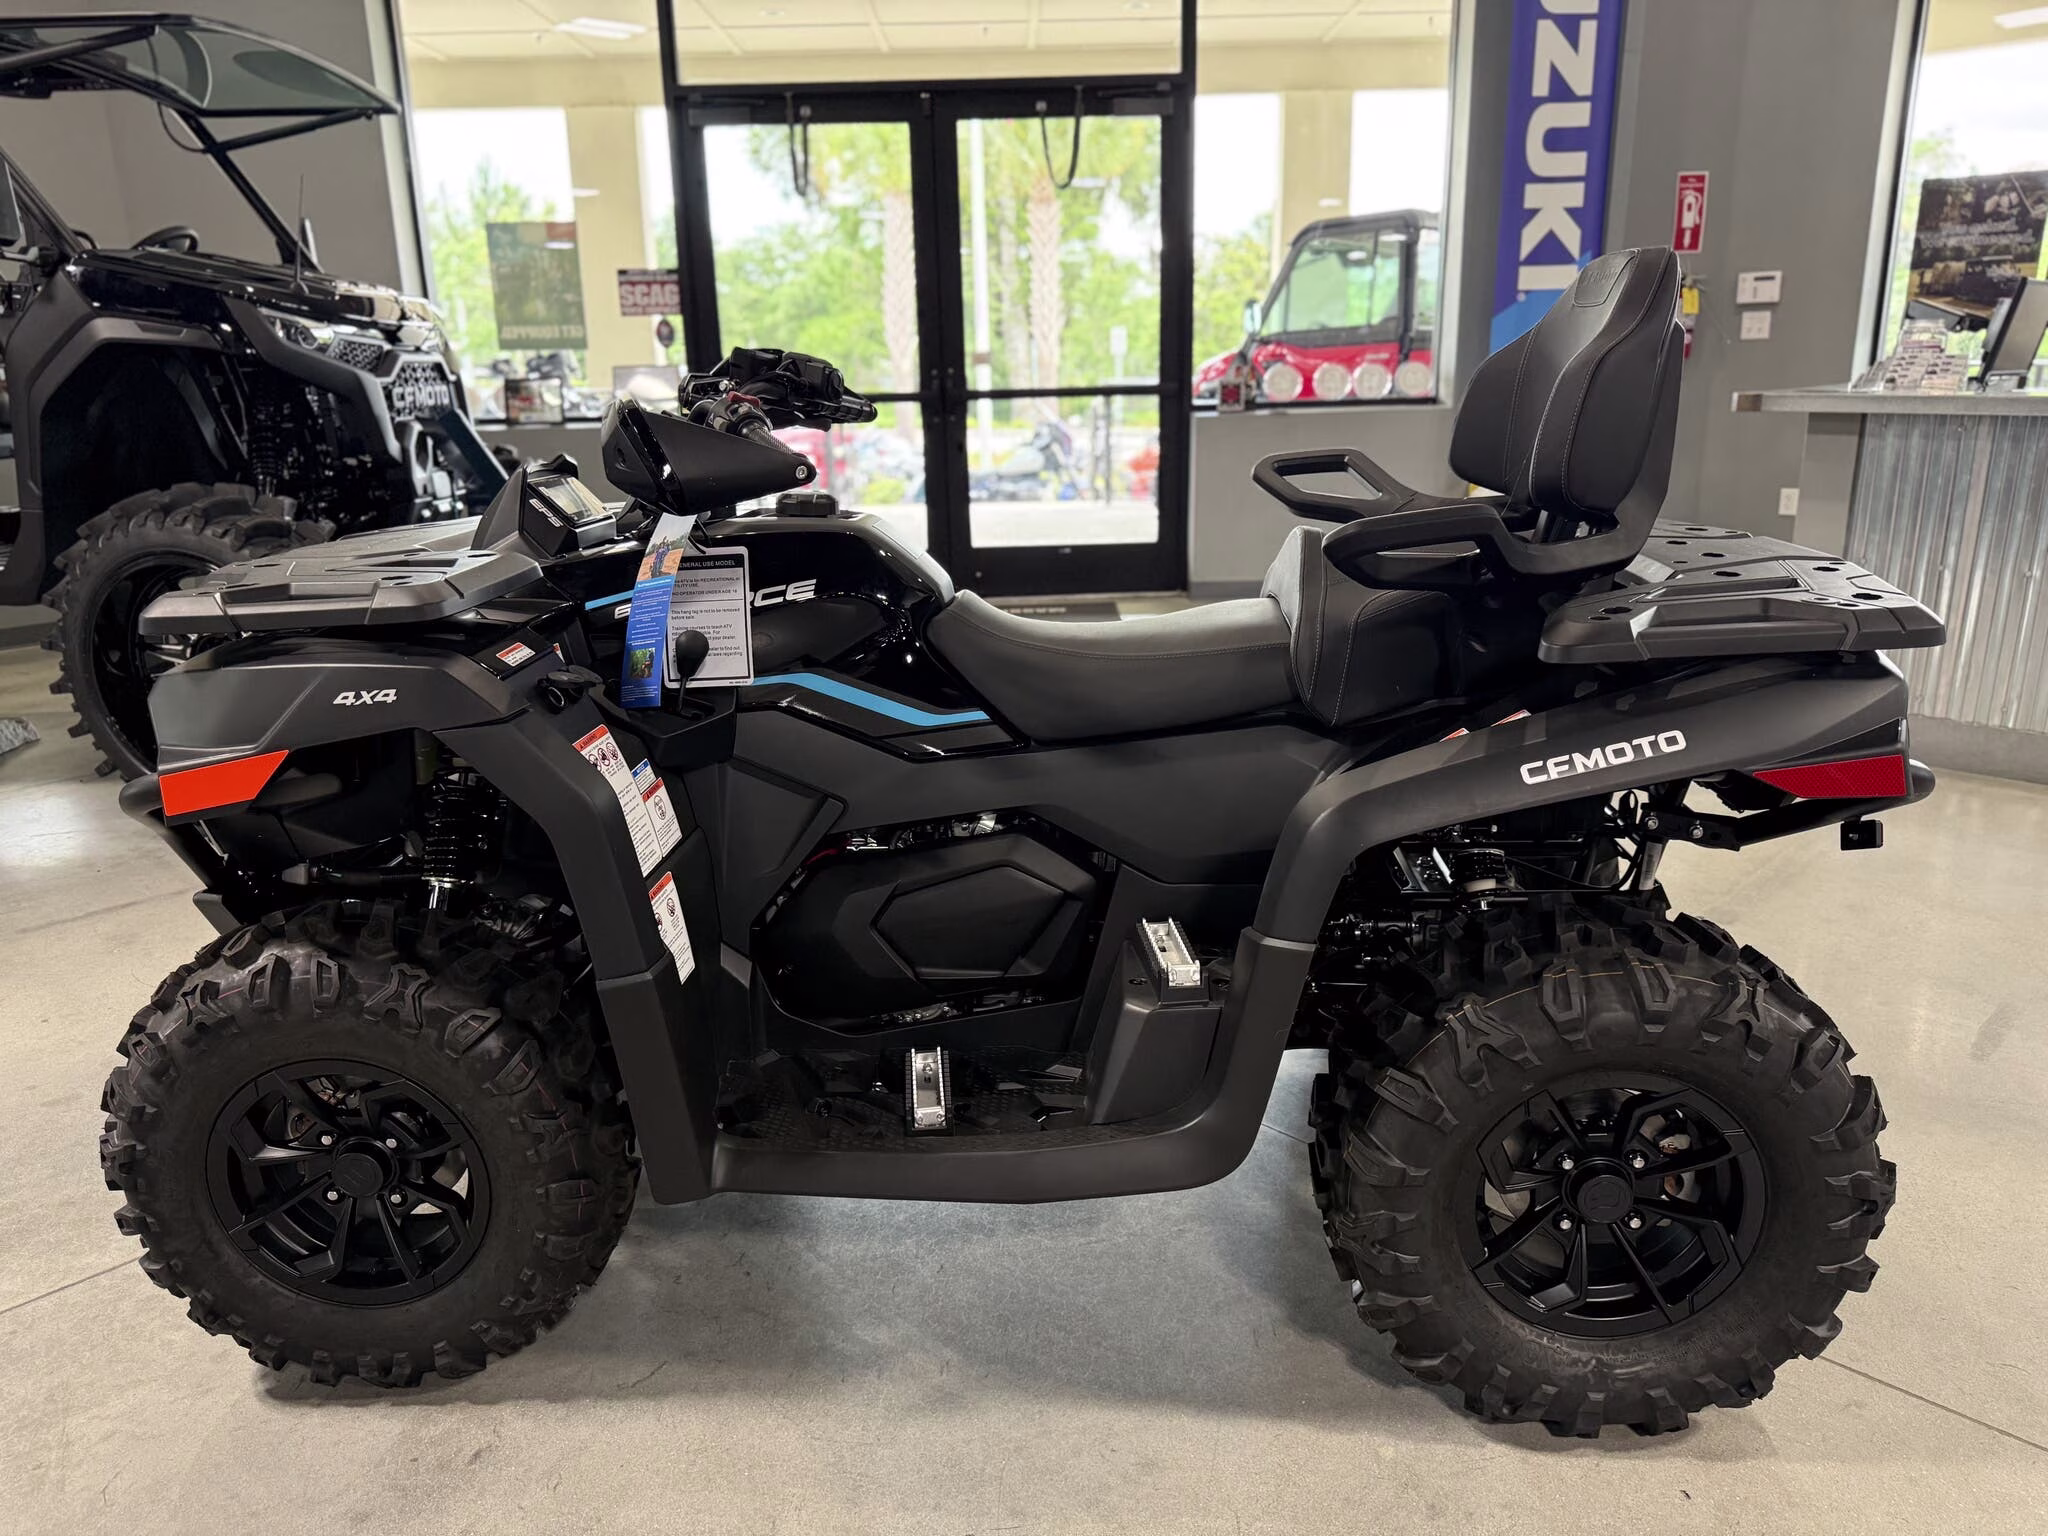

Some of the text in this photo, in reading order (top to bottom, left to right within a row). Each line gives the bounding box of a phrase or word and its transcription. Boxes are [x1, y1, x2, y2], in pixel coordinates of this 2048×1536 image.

[1517, 0, 1599, 291] ZUKI
[620, 283, 680, 306] SCAG
[392, 384, 450, 409] CFMOTO
[529, 498, 564, 528] EPS
[1519, 729, 1687, 785] CFMOTO
